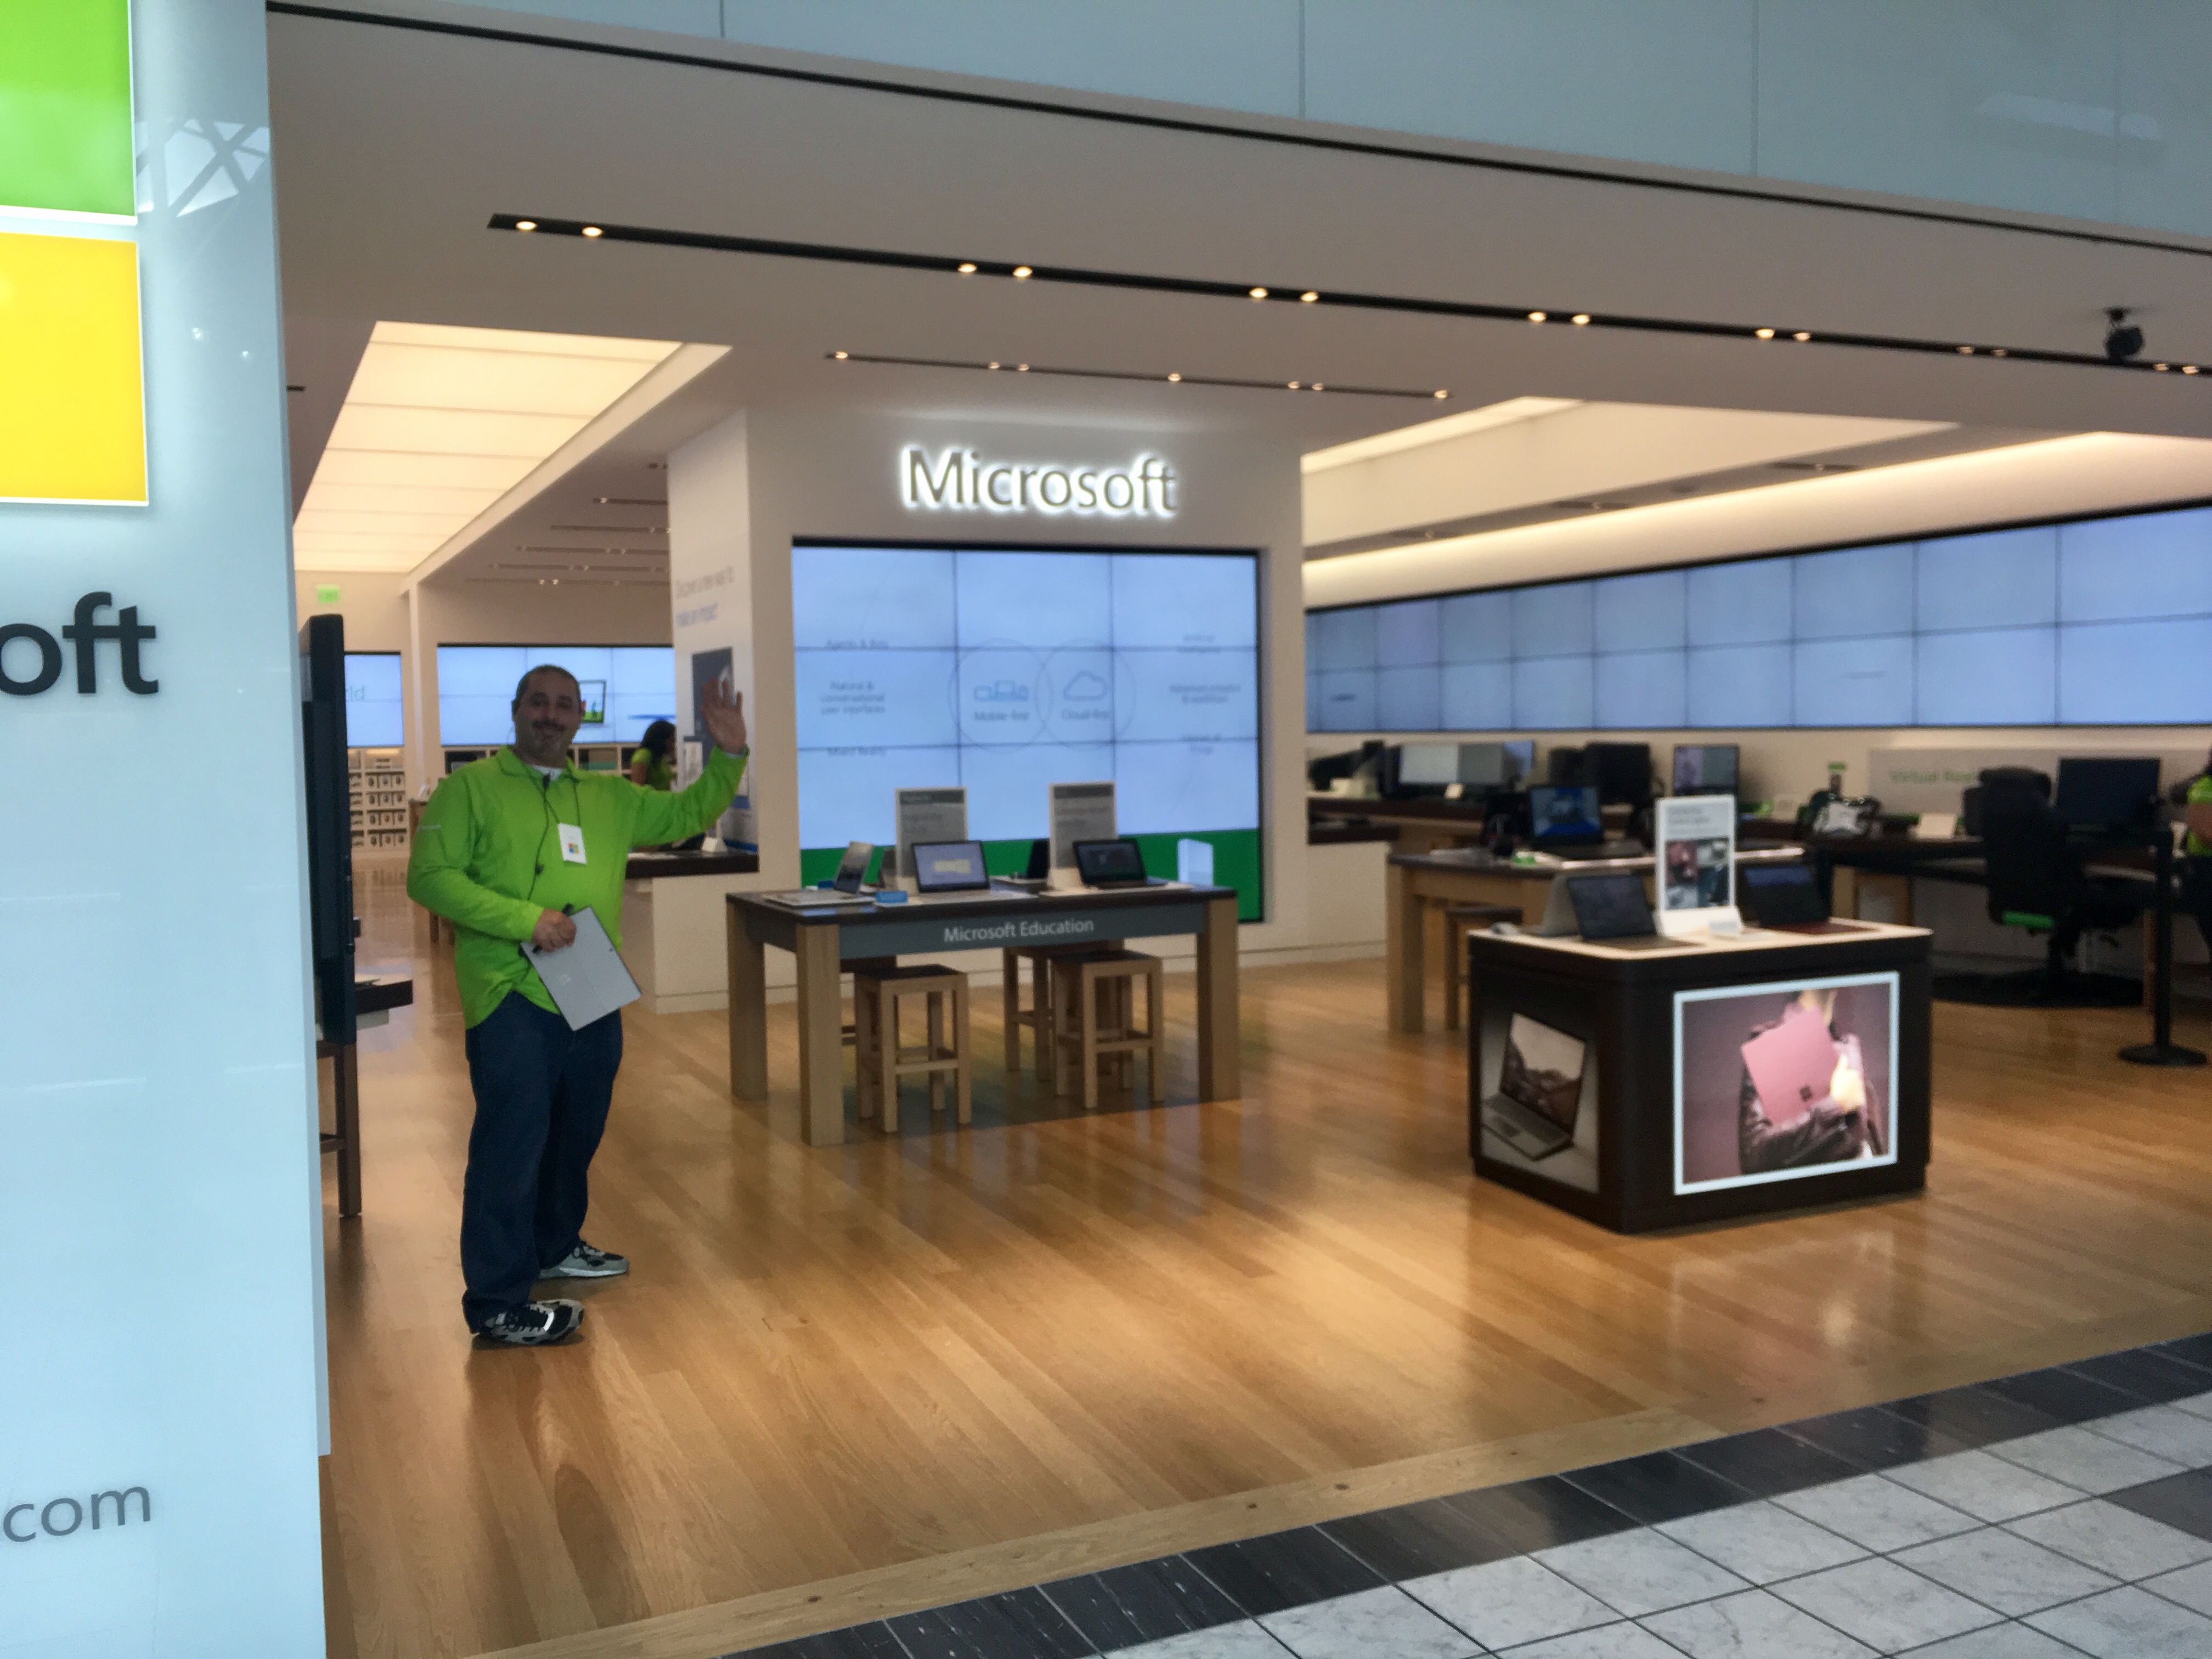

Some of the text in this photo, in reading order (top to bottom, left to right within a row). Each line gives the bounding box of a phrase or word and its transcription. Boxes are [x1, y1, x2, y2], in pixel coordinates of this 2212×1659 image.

[904, 445, 1178, 515] Microsoft
[944, 918, 1094, 942] Microsoft Education
